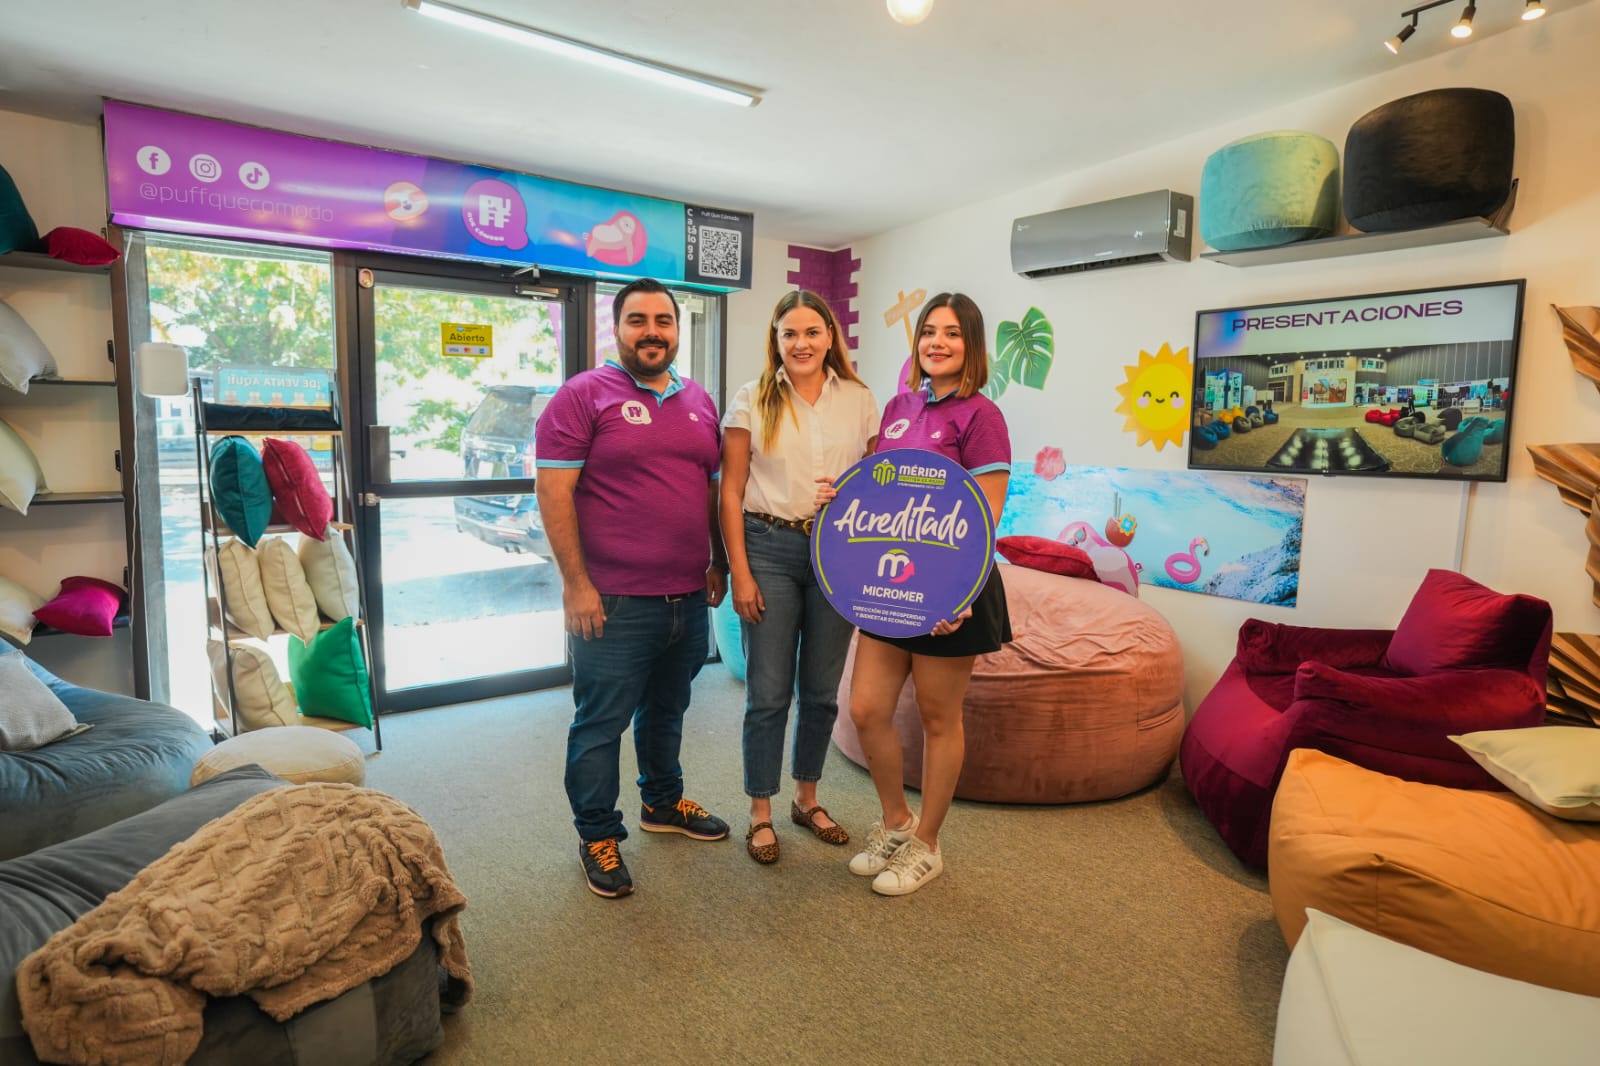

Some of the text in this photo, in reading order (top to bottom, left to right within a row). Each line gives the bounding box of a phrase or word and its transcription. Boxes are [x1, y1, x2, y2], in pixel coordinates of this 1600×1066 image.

[139, 181, 334, 222] @puffquecomodo
[1232, 300, 1463, 332] PRESENTACIONES
[449, 332, 486, 342] Abierto
[899, 464, 947, 479] MÉRIDA
[833, 493, 968, 546] Acreditado
[862, 584, 924, 603] MICROMER
[852, 605, 881, 614] DIRECCIÓN
[889, 610, 926, 621] PROSPERIDAD
[859, 613, 888, 622] BIENESTAR
[887, 617, 922, 627] ECONÓMICO
